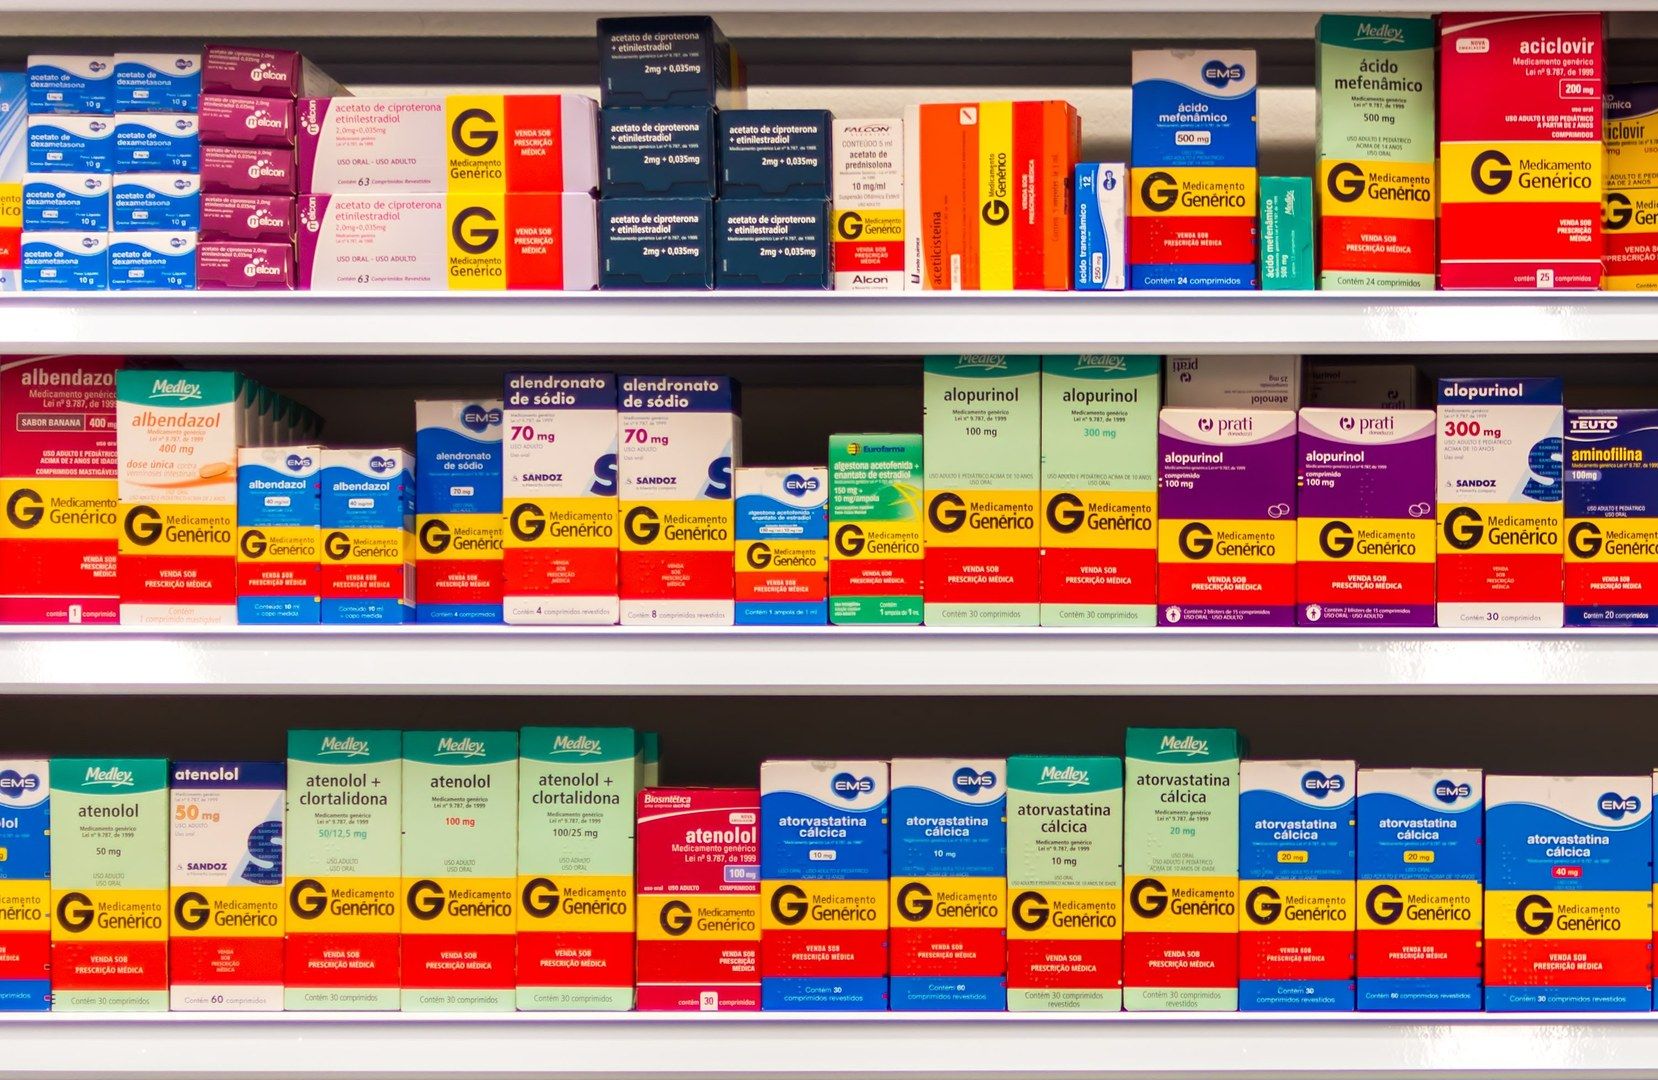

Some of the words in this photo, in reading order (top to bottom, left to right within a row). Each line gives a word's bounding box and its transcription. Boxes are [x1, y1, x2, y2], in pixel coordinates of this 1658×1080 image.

[1520, 37, 1594, 54] aciclovir
[1360, 58, 1398, 73] ácido
[31, 73, 56, 82] acetato
[59, 73, 70, 81] de
[1335, 75, 1423, 92] mefenâmico
[1566, 84, 1582, 93] 200
[1583, 86, 1594, 96] mg
[335, 104, 371, 113] acetato
[373, 103, 385, 112] de
[388, 103, 442, 113] ciproterona
[335, 114, 400, 123] etinilestradiol
[644, 156, 661, 165] 2mg
[668, 155, 700, 165] 0,035mg
[845, 161, 892, 170] prednisolona
[853, 182, 861, 190] 10
[863, 182, 886, 192] mg/ml
[1079, 203, 1087, 258] tranexâmico
[1078, 261, 1088, 284] ácido
[852, 275, 888, 284] Alcon
[1144, 276, 1173, 285] Contém
[1177, 277, 1188, 285] 24
[1189, 277, 1241, 285] comprimidos
[623, 378, 719, 391] alendronato
[623, 394, 642, 407] de
[647, 394, 689, 407] sódio
[21, 418, 46, 428] SABOR
[132, 411, 220, 428] albendazol
[1570, 420, 1618, 429] TEUTO
[966, 427, 981, 435] 100
[984, 429, 997, 438] mg
[1165, 452, 1223, 465] alopurinol
[1572, 447, 1643, 461] aminofilina
[126, 460, 148, 469] dose
[150, 460, 174, 469] única
[175, 767, 239, 780] atenolol
[300, 791, 387, 805] clortalidona
[779, 816, 867, 827] atorvastatina
[319, 829, 351, 839] 50/12,5
[353, 831, 367, 840] mg
[799, 826, 847, 839] cálcica
[1556, 867, 1566, 876] 40
[1568, 869, 1579, 878] mg
[1533, 961, 1576, 972] PRESCRIÇÃO
[1577, 960, 1603, 971] MÉDICA
